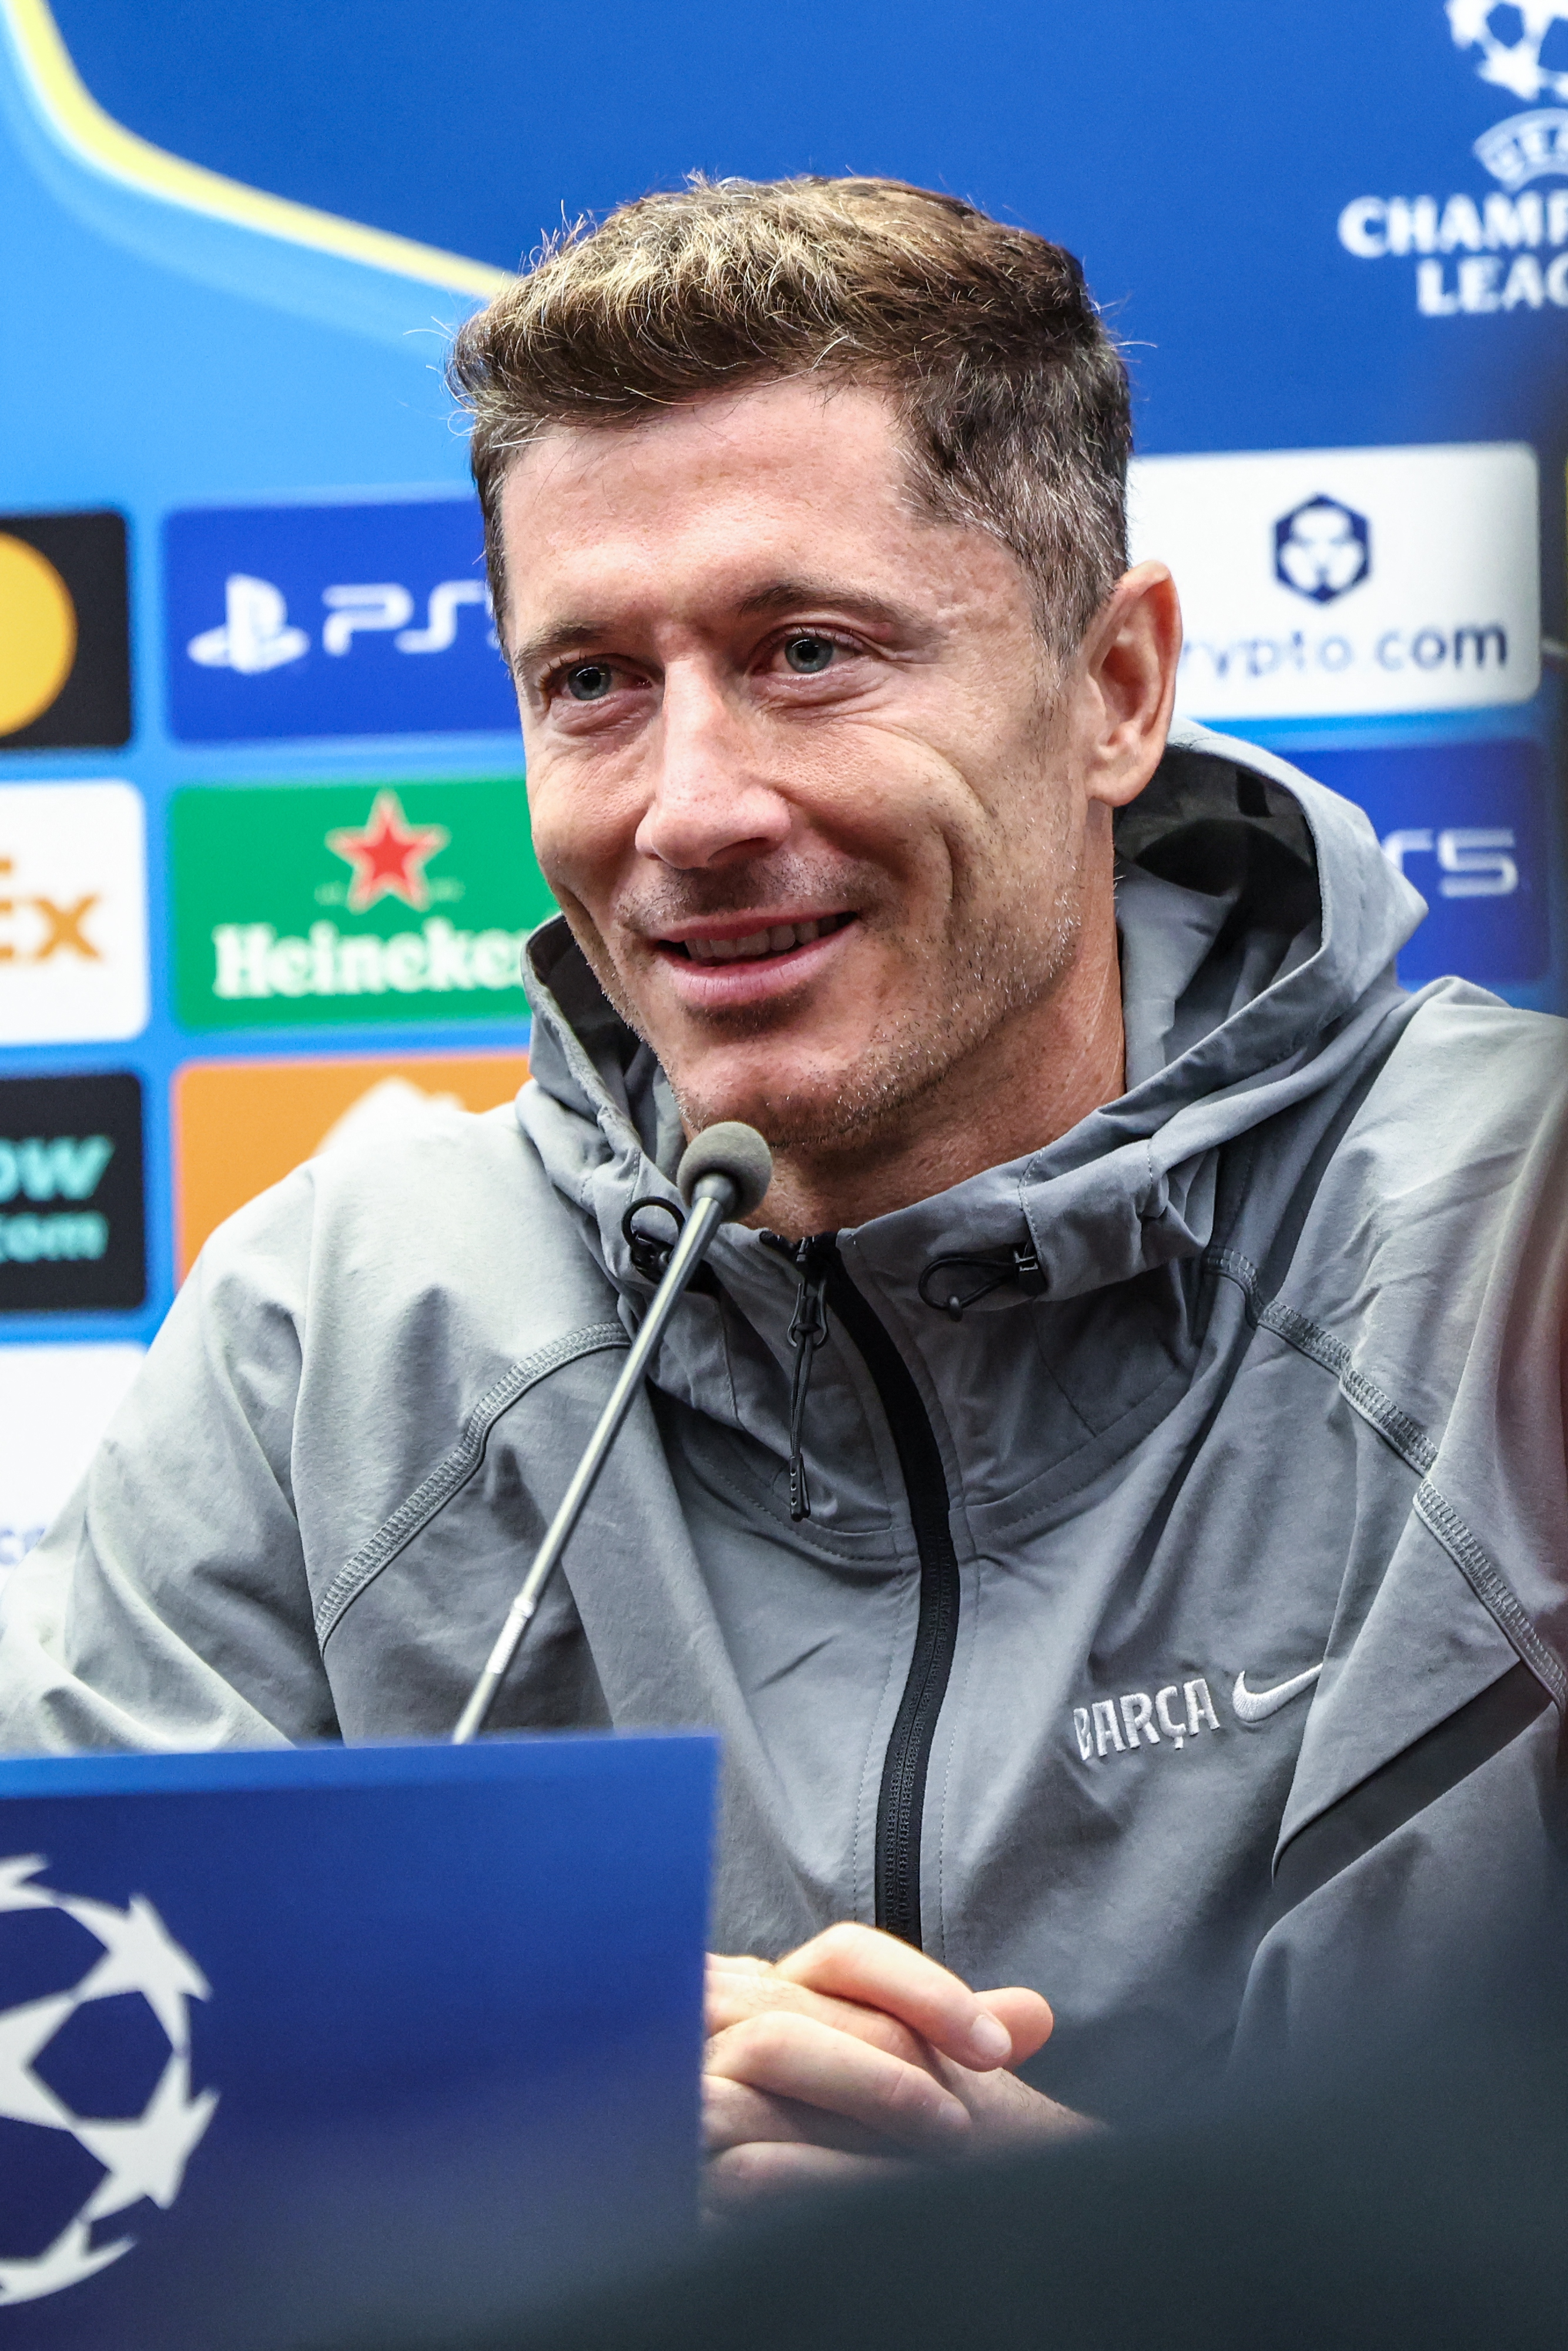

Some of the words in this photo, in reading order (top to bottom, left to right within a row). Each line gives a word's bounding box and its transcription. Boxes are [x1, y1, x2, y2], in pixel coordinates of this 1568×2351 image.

[323, 581, 498, 655] PS
[213, 918, 529, 997] Heineke
[1073, 1678, 1221, 1761] BARÇA
